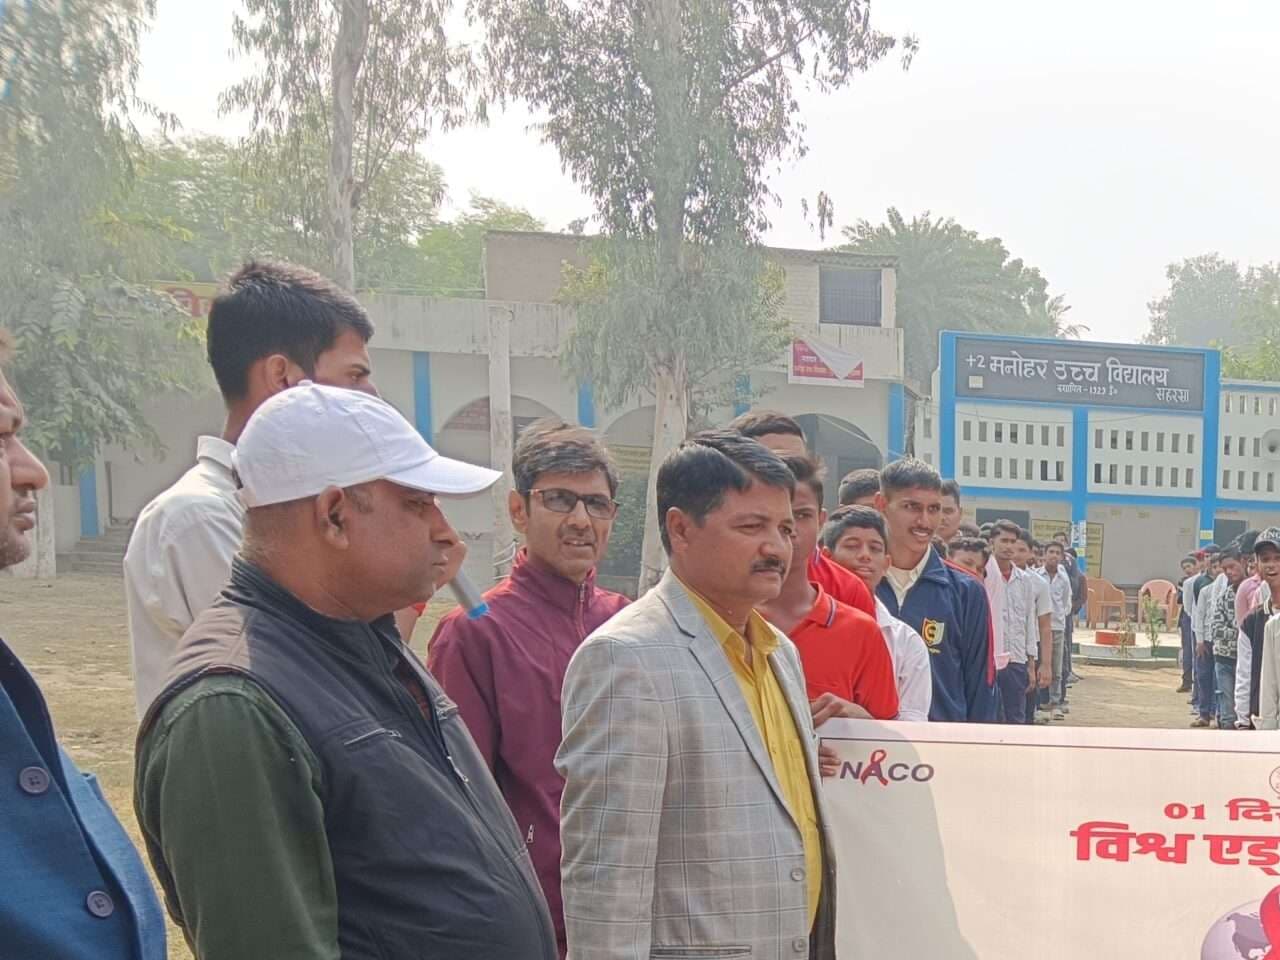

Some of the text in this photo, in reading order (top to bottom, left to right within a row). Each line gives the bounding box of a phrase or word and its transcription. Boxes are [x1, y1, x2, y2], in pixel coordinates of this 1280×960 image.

[966, 350, 1169, 387] +2 मनोहर उच्च विद्यालय
[1155, 387, 1190, 402] सहरसा
[840, 754, 935, 785] NACO
[1164, 803, 1206, 820] 01
[1069, 821, 1196, 864] विश्व
